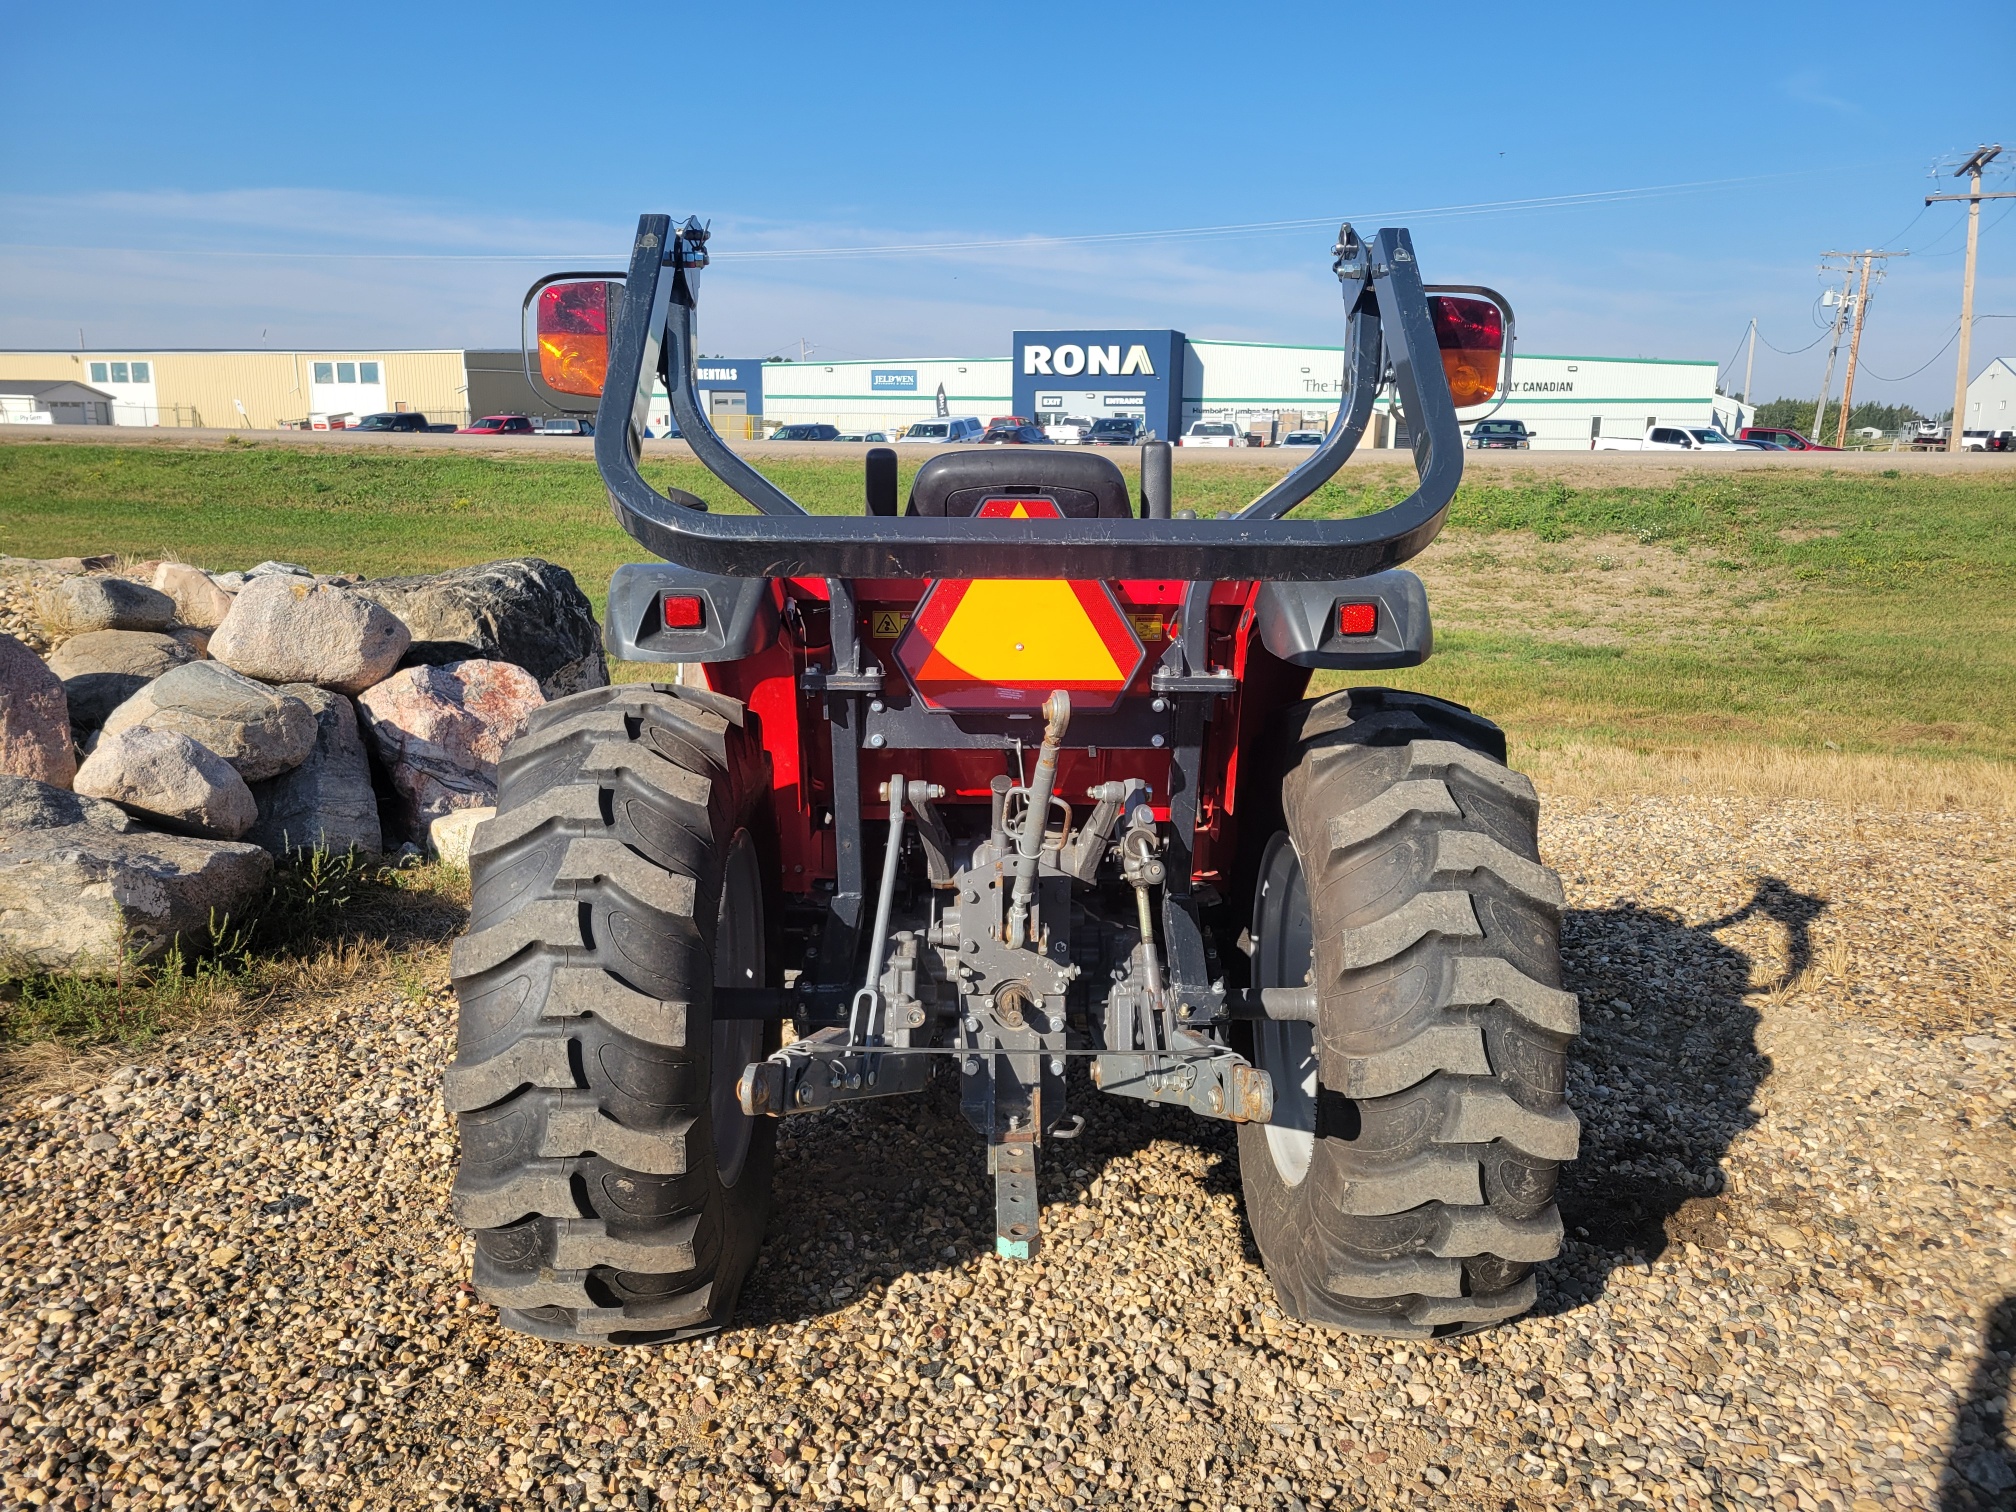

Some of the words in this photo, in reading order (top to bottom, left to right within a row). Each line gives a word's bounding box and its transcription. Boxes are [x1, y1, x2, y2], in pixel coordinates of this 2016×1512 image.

[1024, 344, 1155, 375] RONA
[697, 368, 737, 380] RENTALS
[1303, 379, 1328, 392] The
[1523, 382, 1573, 392] CANADIAN
[1106, 397, 1143, 405] ENTRANCE
